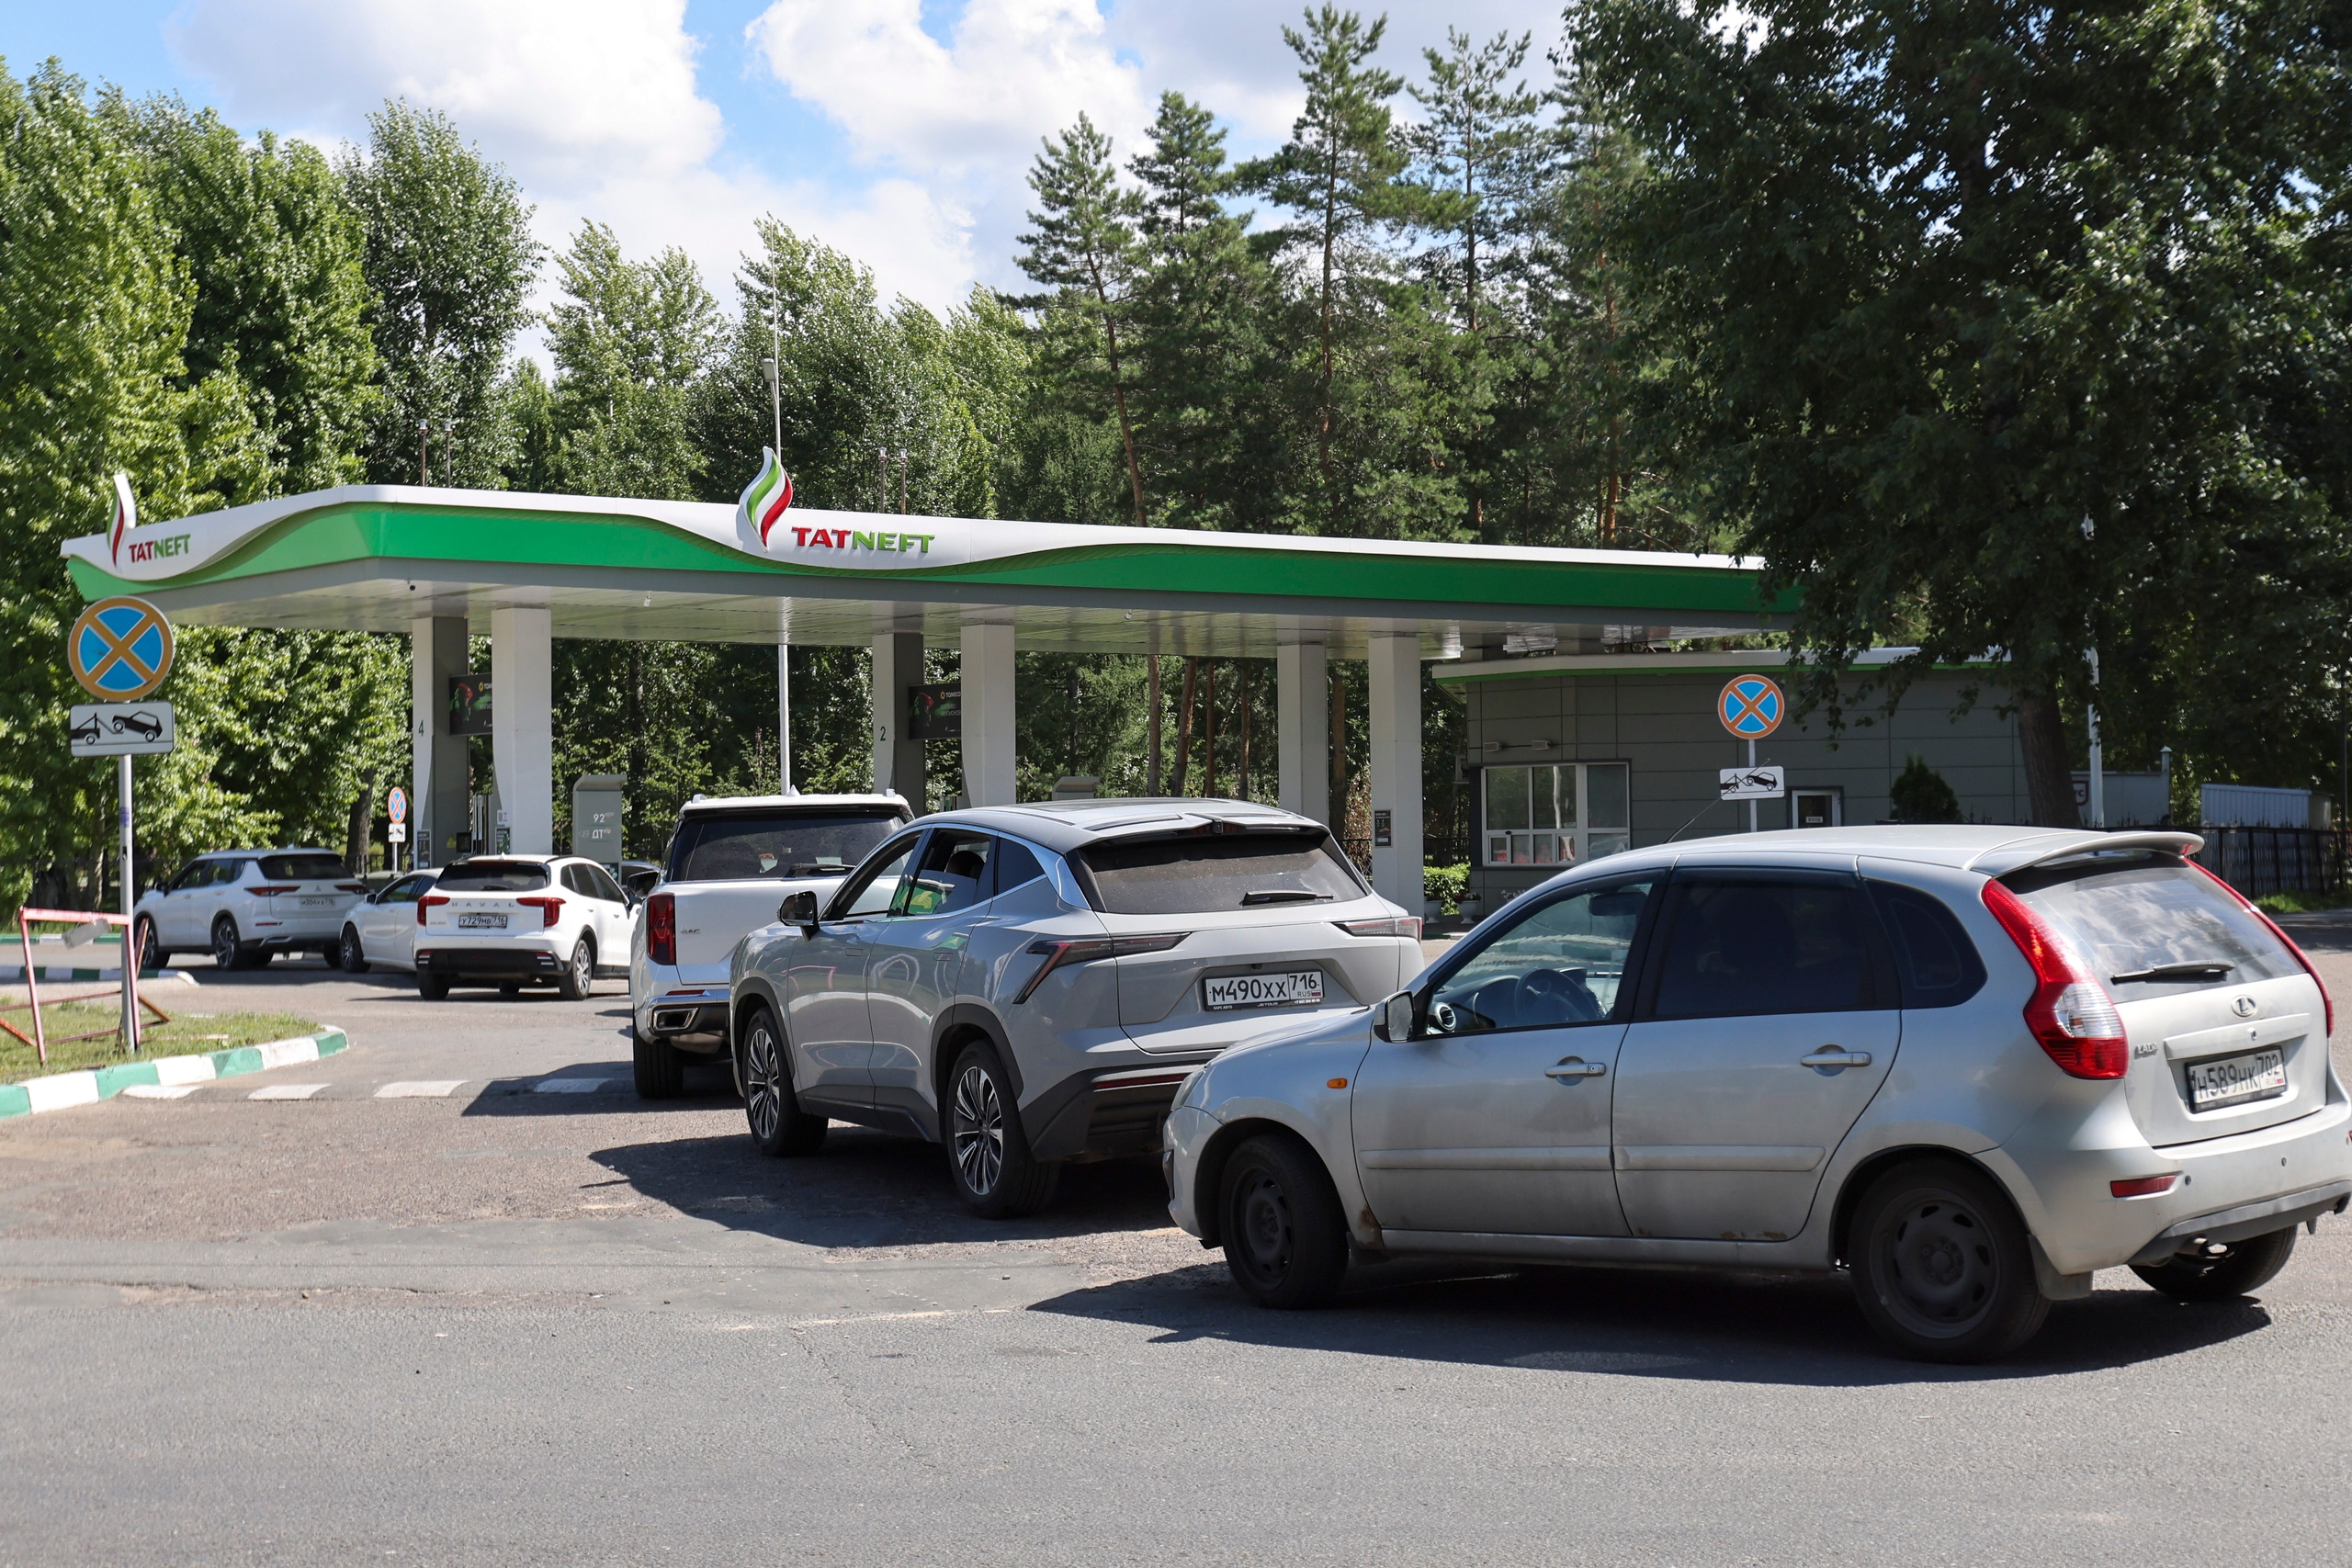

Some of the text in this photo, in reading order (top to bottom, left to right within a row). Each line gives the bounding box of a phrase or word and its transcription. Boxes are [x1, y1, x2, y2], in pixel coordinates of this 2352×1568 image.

[129, 534, 191, 563] TATNEFT
[792, 526, 935, 553] TATNEFT
[418, 719, 424, 737] 4
[880, 726, 886, 741] 2
[593, 813, 605, 823] 92
[592, 829, 605, 839] ДТ
[1212, 974, 1317, 1002] М490ХХ 716
[2136, 1042, 2157, 1055] LADA
[2257, 1054, 2280, 1078] 702
